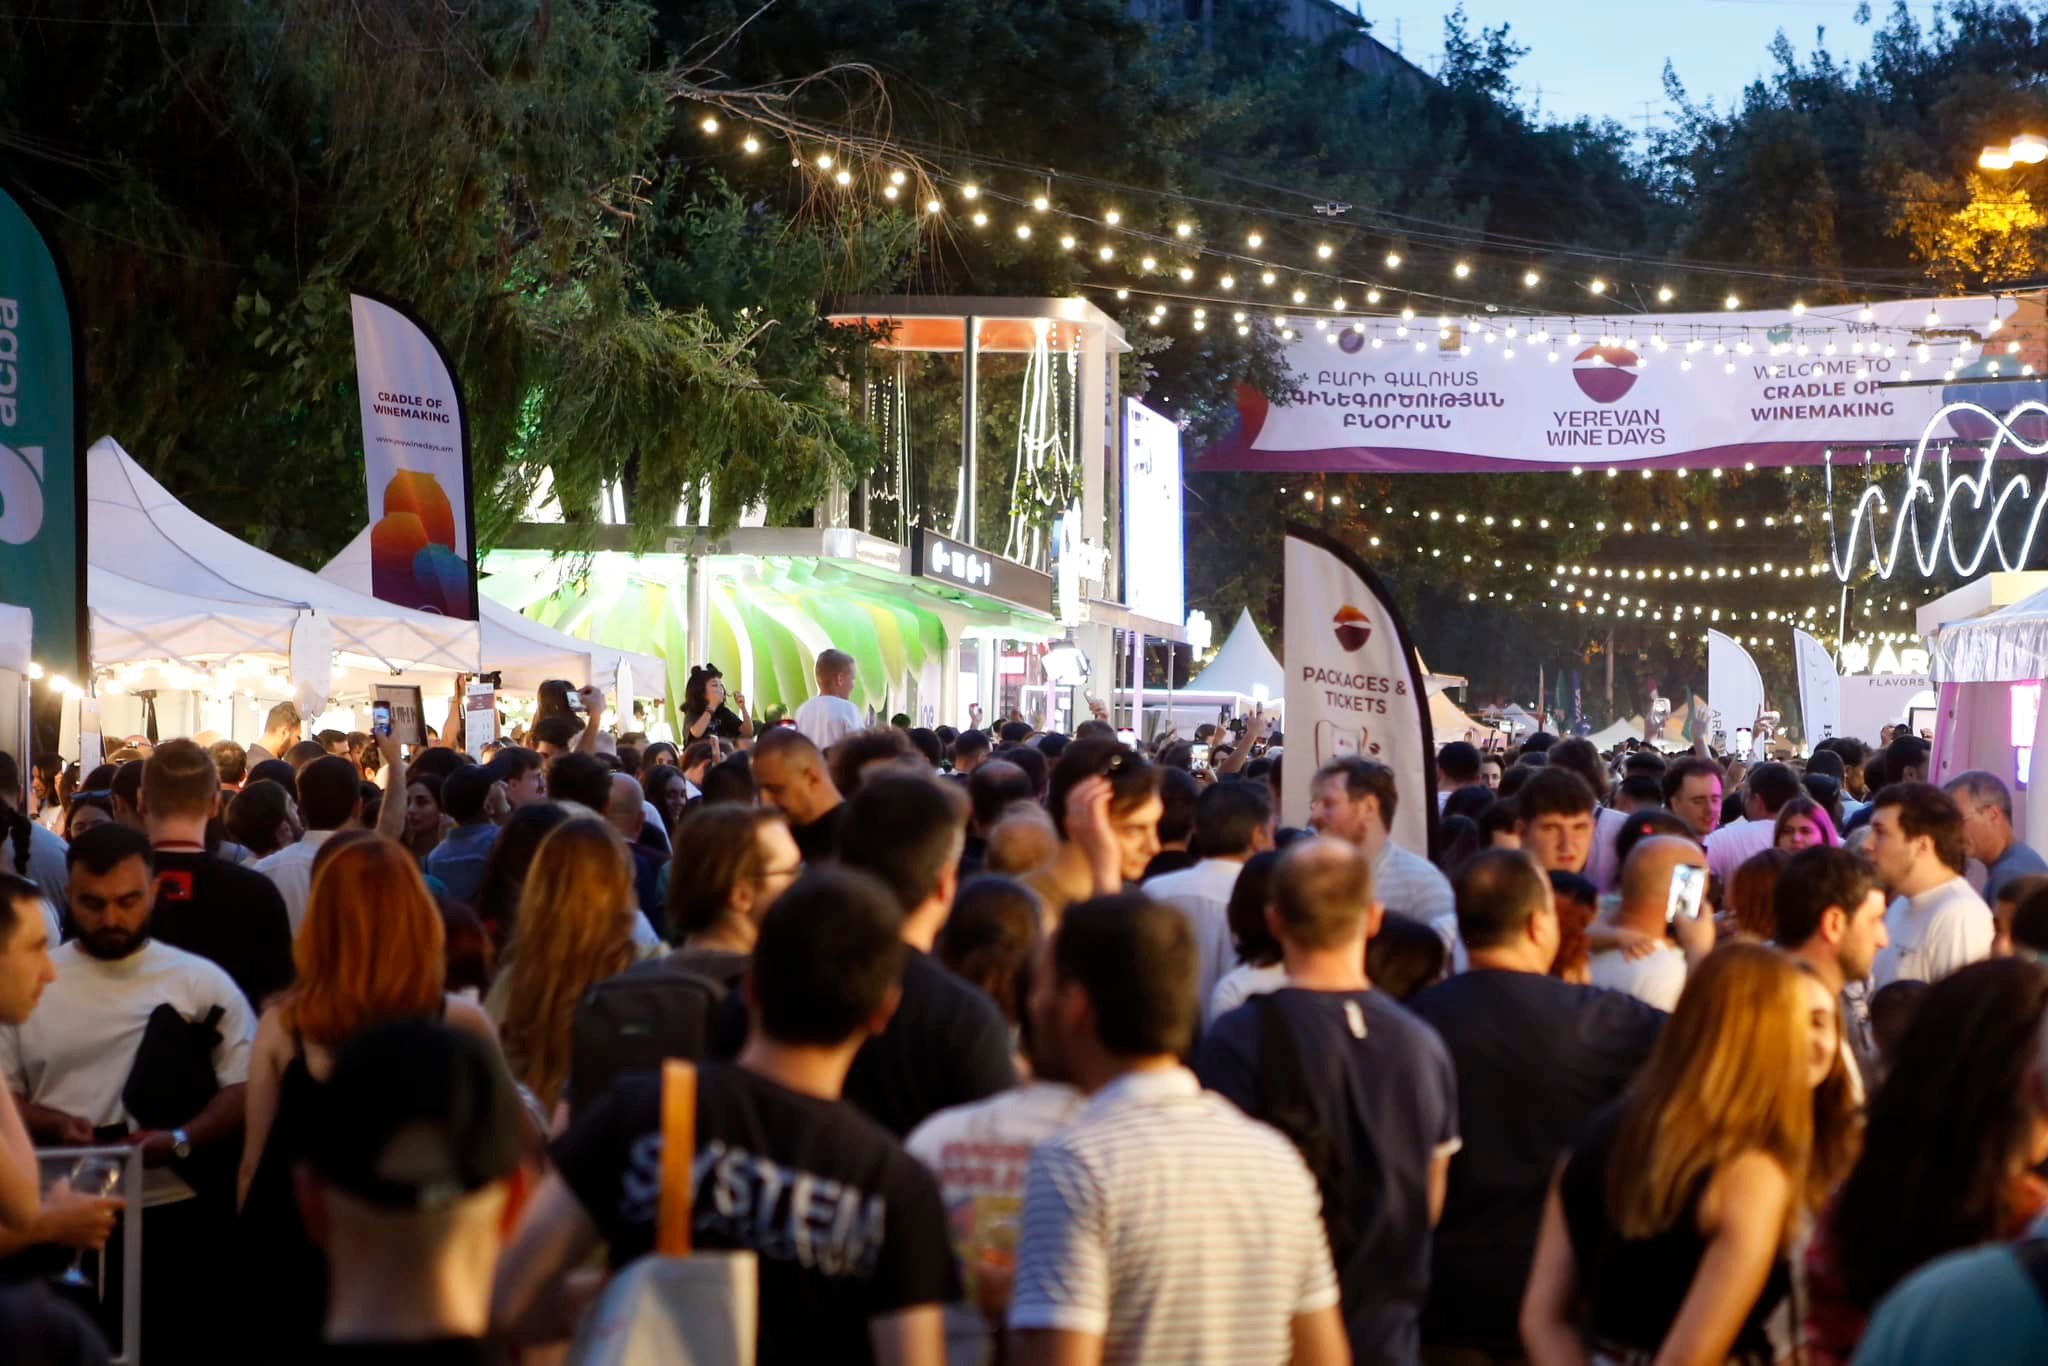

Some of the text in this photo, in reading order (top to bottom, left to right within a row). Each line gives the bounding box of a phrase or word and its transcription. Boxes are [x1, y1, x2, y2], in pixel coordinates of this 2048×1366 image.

[0, 297, 19, 428] acba
[1752, 358, 1892, 381] WELCOME TO
[1318, 370, 1479, 388] ԲԱՐԻ ԳԱԼՈՒՍՏ
[378, 391, 443, 409] CRADLE OF
[1763, 382, 1846, 401] CRADLE
[373, 404, 450, 423] WINEMAKING
[1552, 408, 1661, 428] YEREVAN
[1750, 401, 1895, 422] WINEMAKING
[1546, 428, 1666, 446] WINE DAYS
[1302, 666, 1407, 696] PACKAGES &
[1868, 678, 1926, 688] FLAVORS
[1325, 690, 1387, 714] TICKETS
